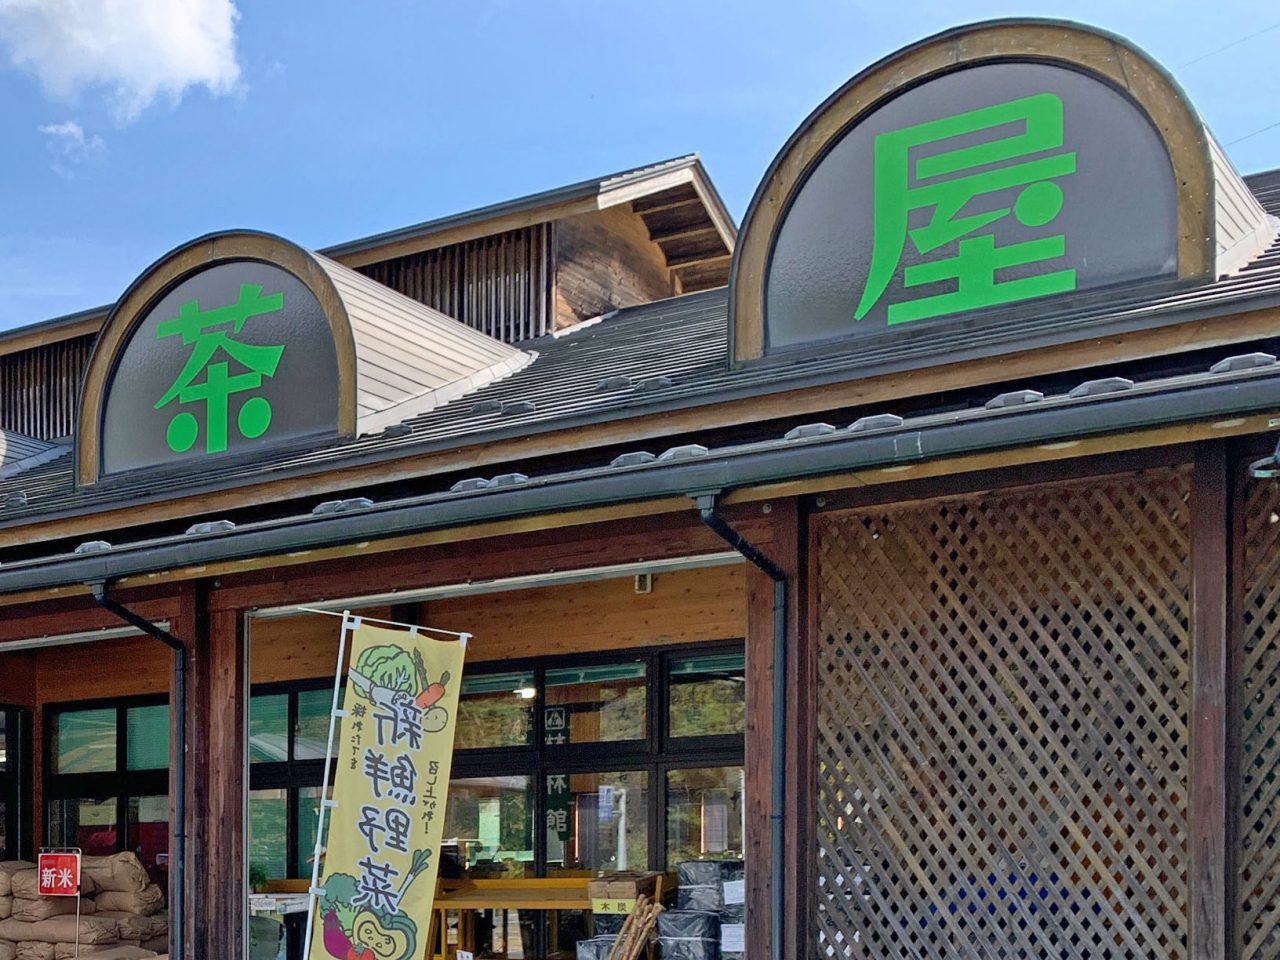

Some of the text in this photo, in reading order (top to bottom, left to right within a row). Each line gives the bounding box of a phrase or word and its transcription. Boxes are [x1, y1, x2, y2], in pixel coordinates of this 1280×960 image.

[153, 283, 286, 454] 茶
[854, 93, 1076, 325] 屋
[41, 867, 73, 888] 新米
